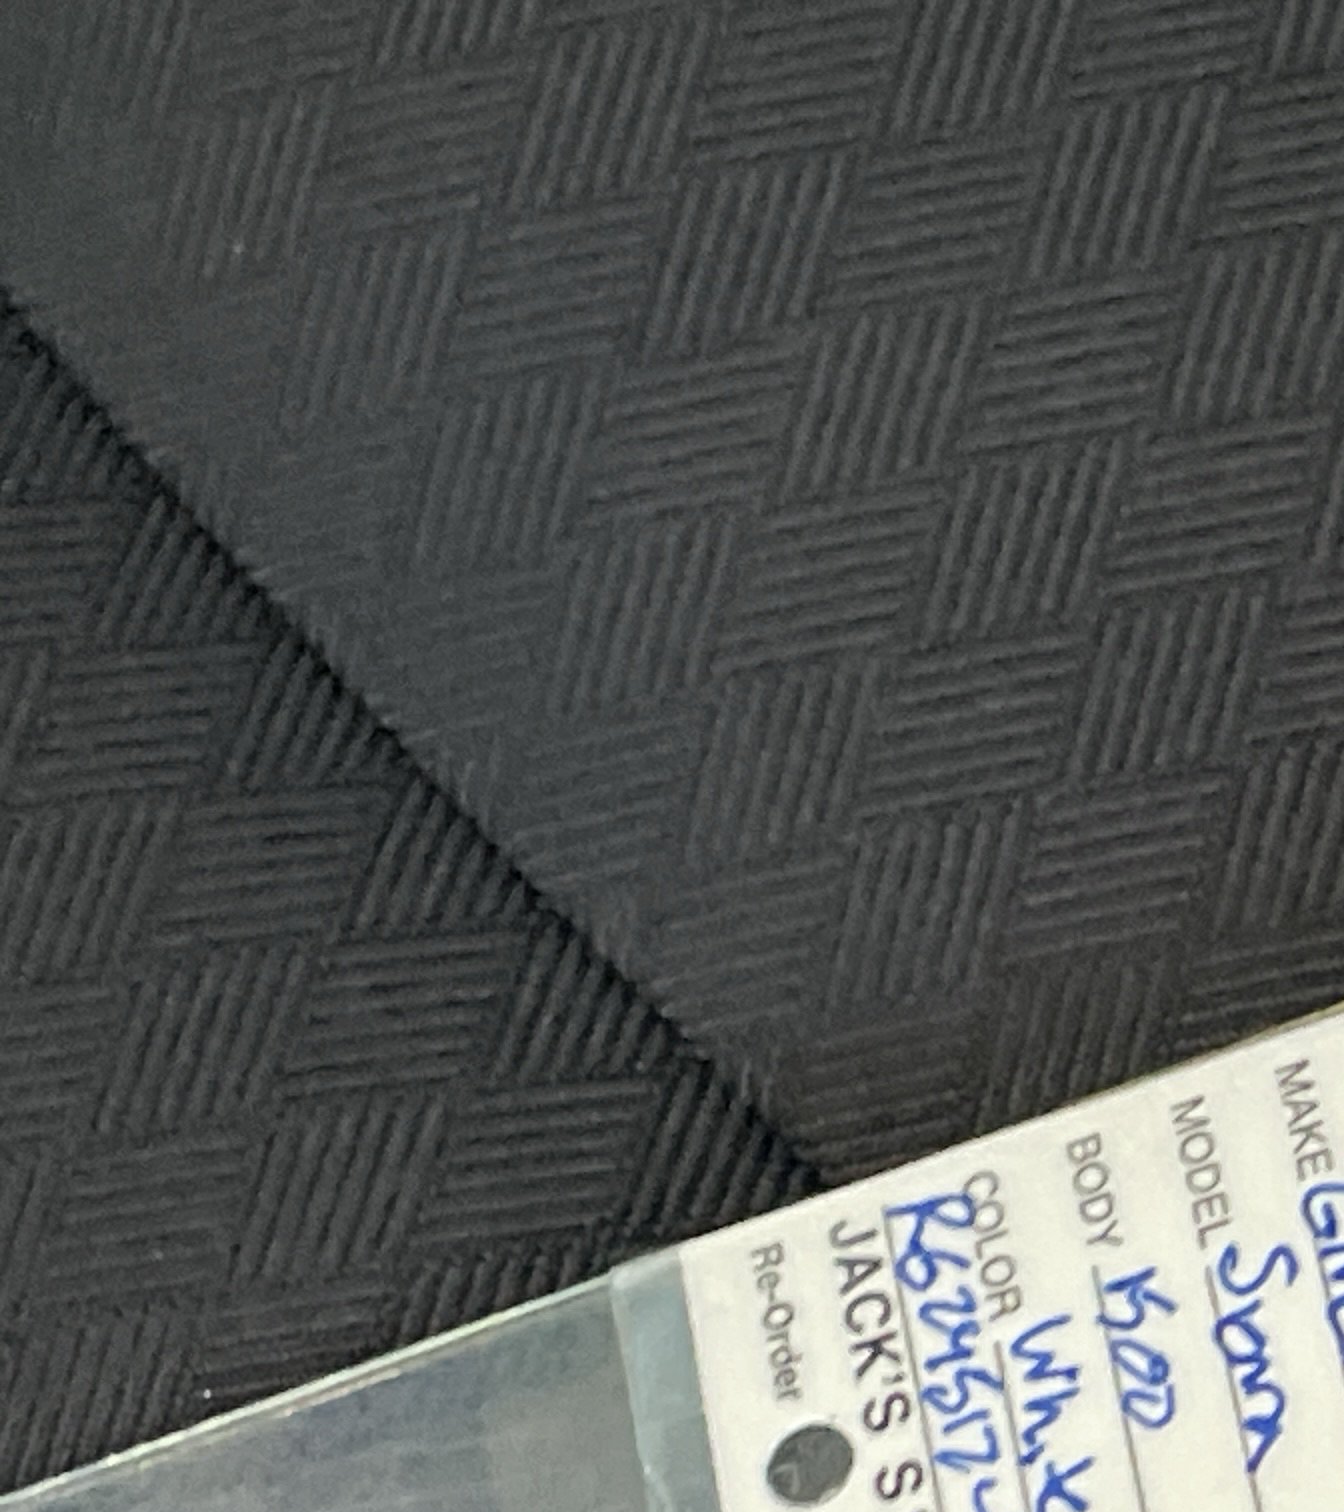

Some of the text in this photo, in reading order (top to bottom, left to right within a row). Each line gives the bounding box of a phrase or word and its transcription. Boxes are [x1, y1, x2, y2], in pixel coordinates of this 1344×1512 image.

[1066, 1131, 1124, 1247] BODY
[1170, 1095, 1233, 1251] MODEL
[1274, 1059, 1335, 1182] MAKE
[750, 1242, 803, 1401] Re-Order
[962, 1170, 1024, 1323] COLOR
[830, 1219, 912, 1436] JACK'S
[873, 1458, 925, 1504] S
